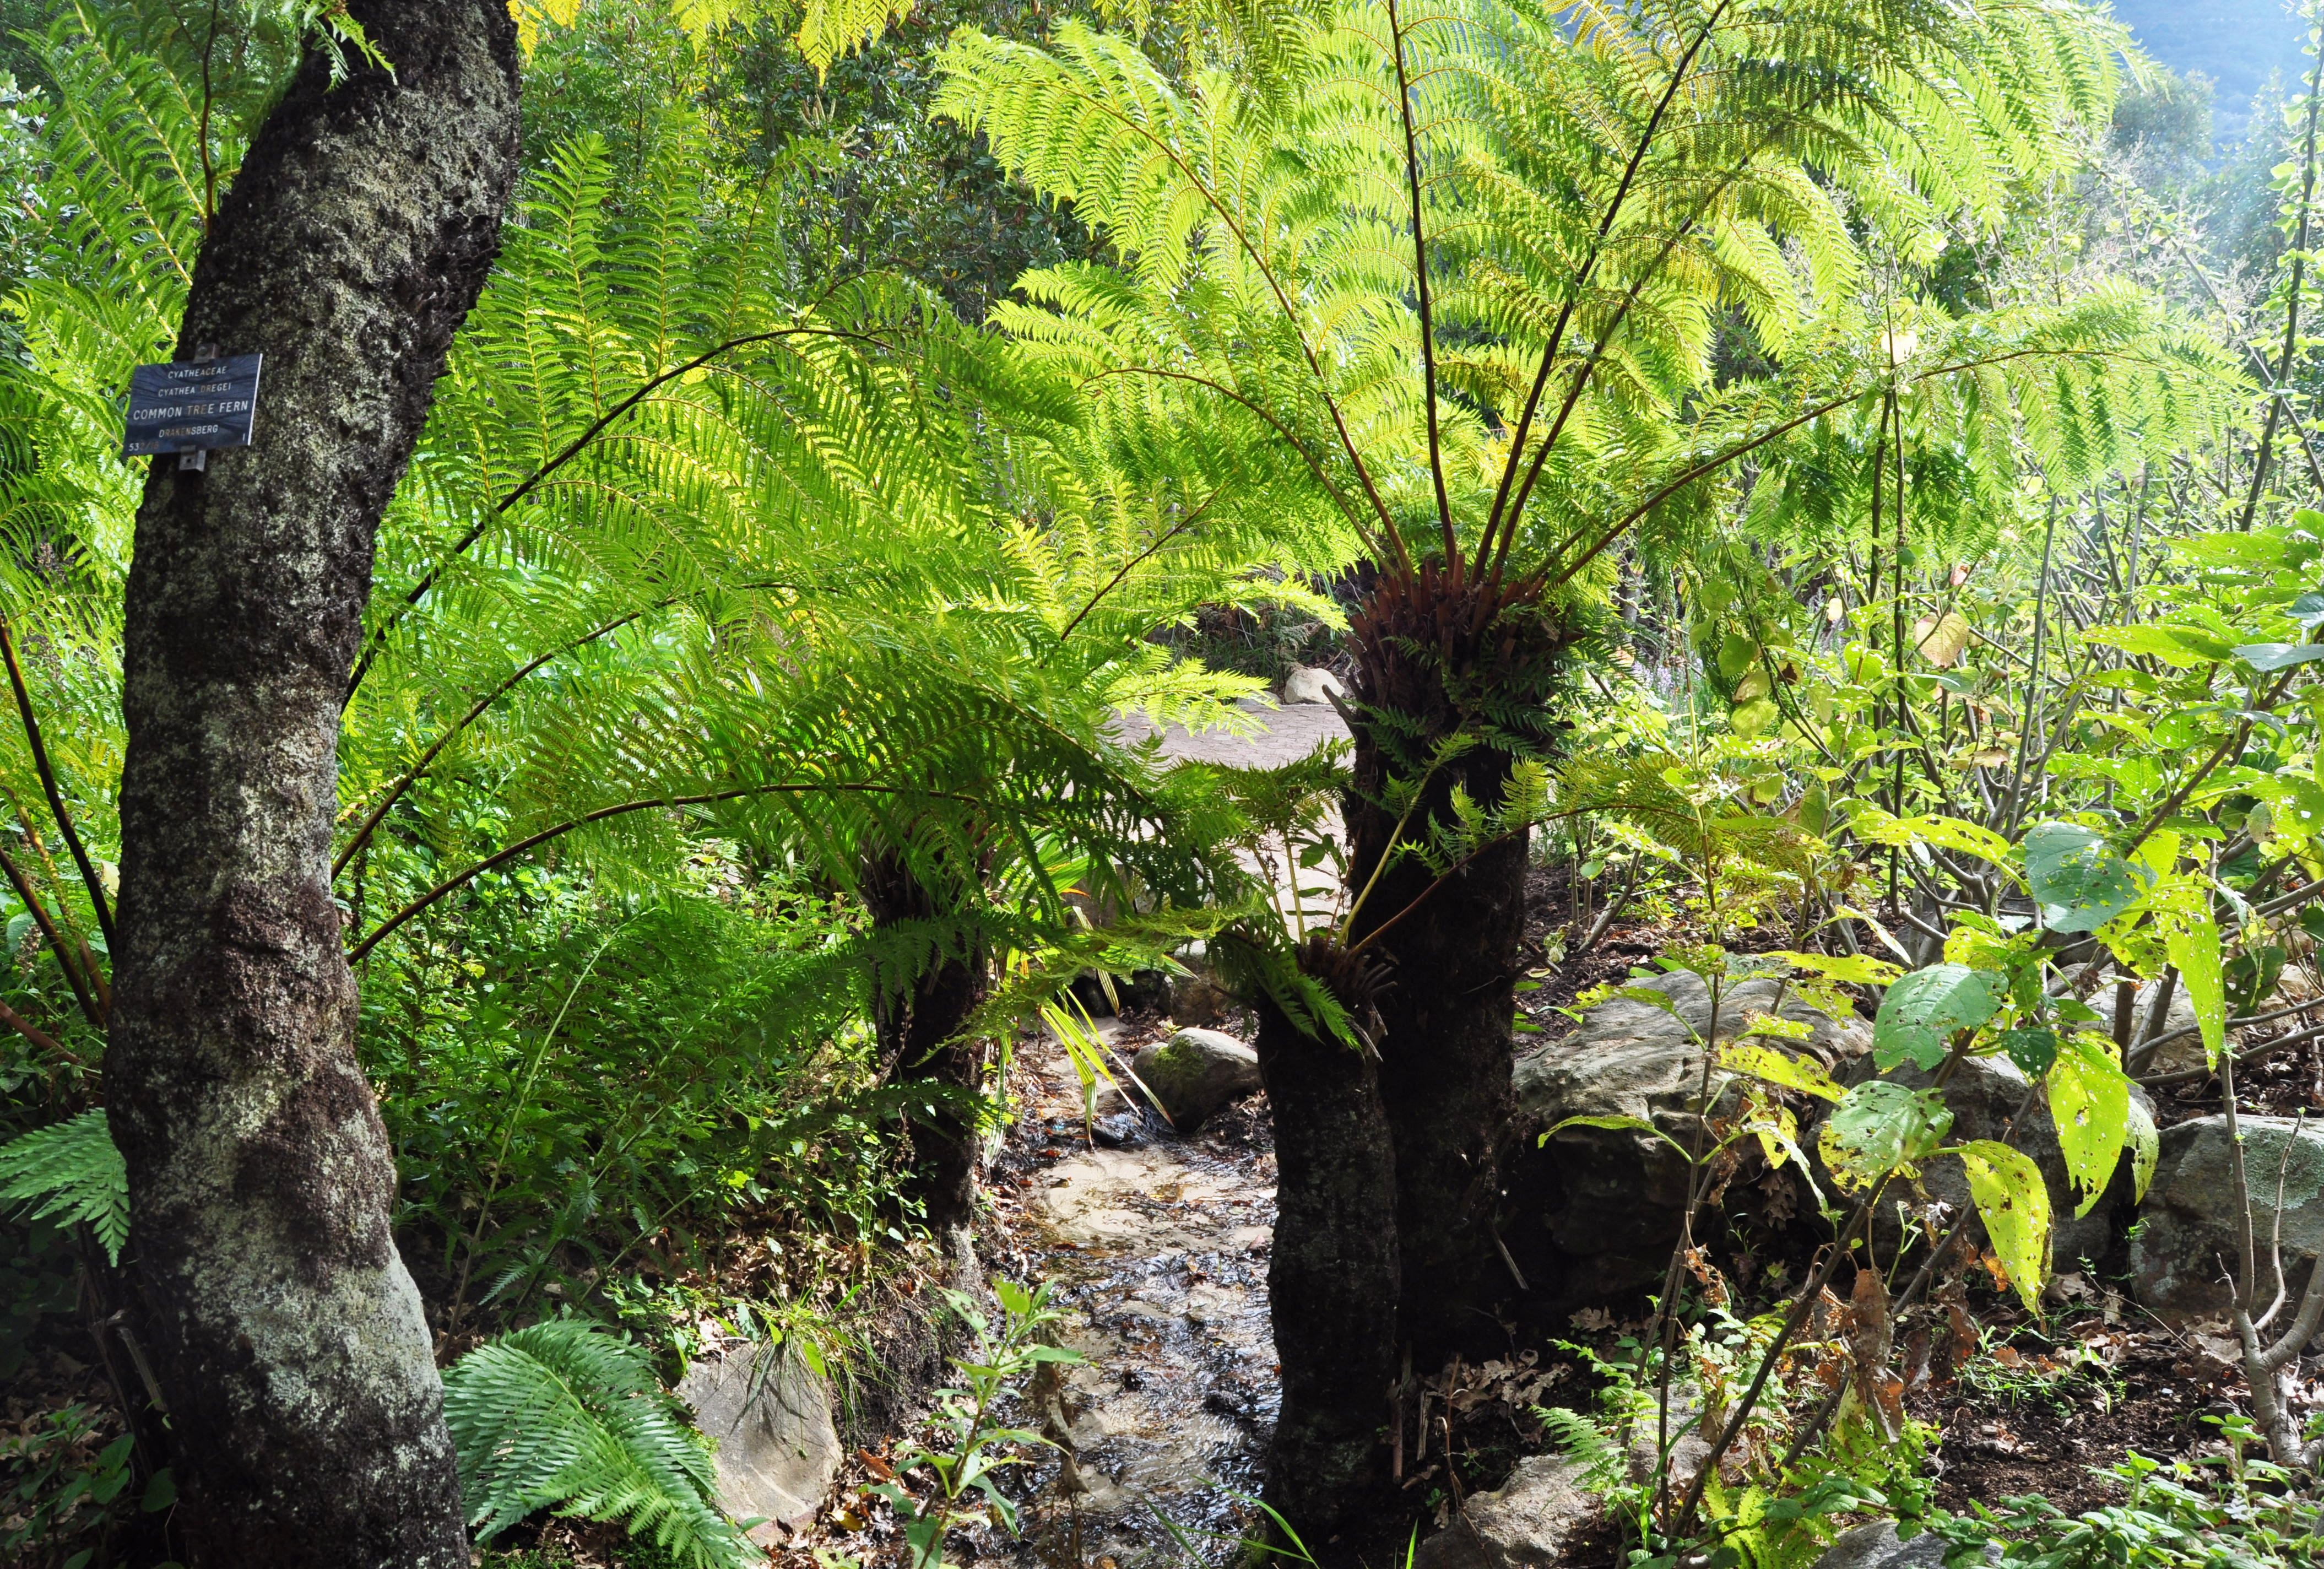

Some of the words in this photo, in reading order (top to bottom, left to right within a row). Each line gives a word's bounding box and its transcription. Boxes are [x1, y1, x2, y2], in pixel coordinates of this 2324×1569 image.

[168, 366, 226, 379] CYATHEACEAE
[158, 386, 195, 397] CYATHEA
[201, 383, 231, 392] DREGEI
[133, 407, 182, 420] COMMON
[187, 404, 215, 415] TREE
[219, 401, 248, 413] FERN
[159, 425, 218, 437] DRAKENSBERG
